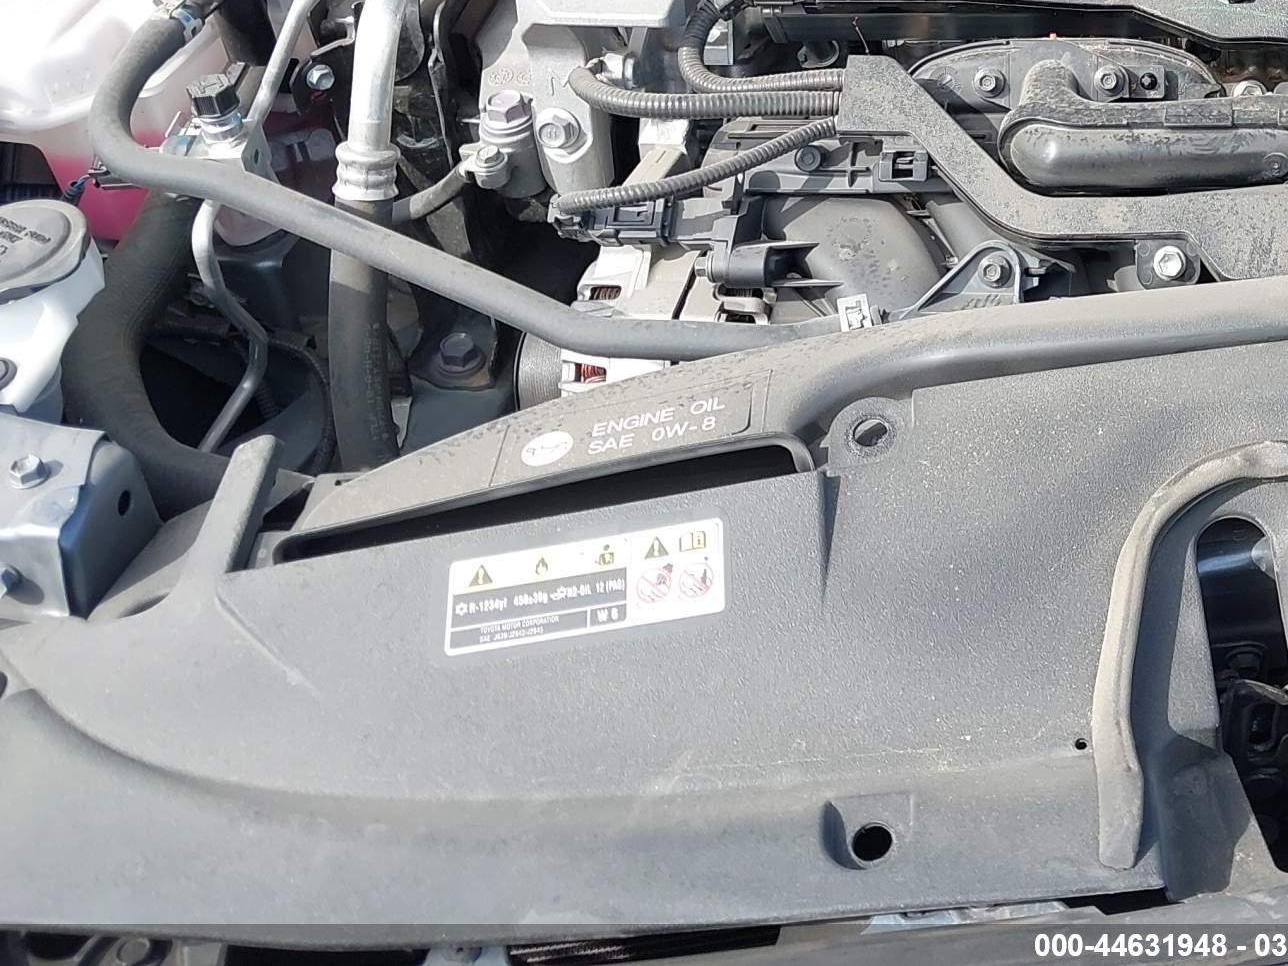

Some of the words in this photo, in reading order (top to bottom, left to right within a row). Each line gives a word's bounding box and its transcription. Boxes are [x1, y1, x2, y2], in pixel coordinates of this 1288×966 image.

[592, 407, 675, 438] ENGINE
[690, 396, 726, 416] OIL
[587, 433, 635, 455] SAE
[480, 624, 501, 634] TOYOTA
[502, 620, 521, 631] MOTOR
[522, 616, 560, 628] CORPORATION
[597, 608, 608, 622] W
